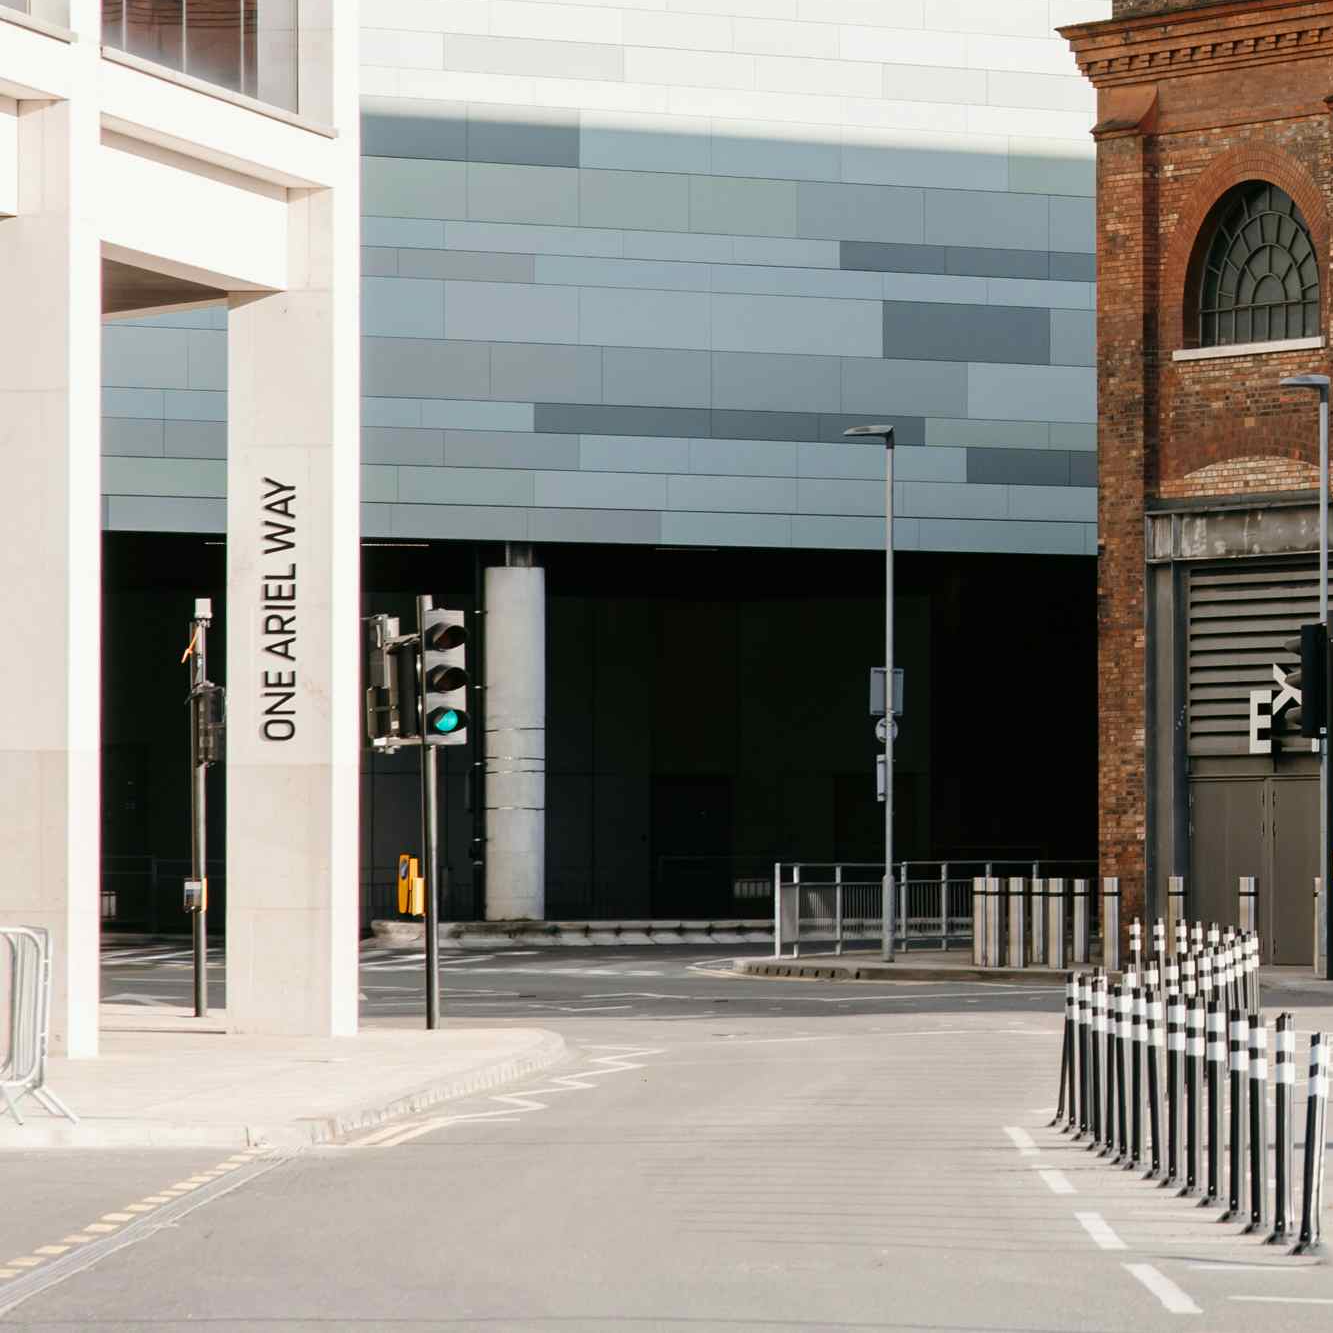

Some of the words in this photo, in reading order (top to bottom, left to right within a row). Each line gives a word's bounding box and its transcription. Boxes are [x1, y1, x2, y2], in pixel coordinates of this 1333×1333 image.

[263, 477, 296, 554] WAY
[263, 564, 296, 661] ARIEL
[263, 671, 296, 741] ONE
